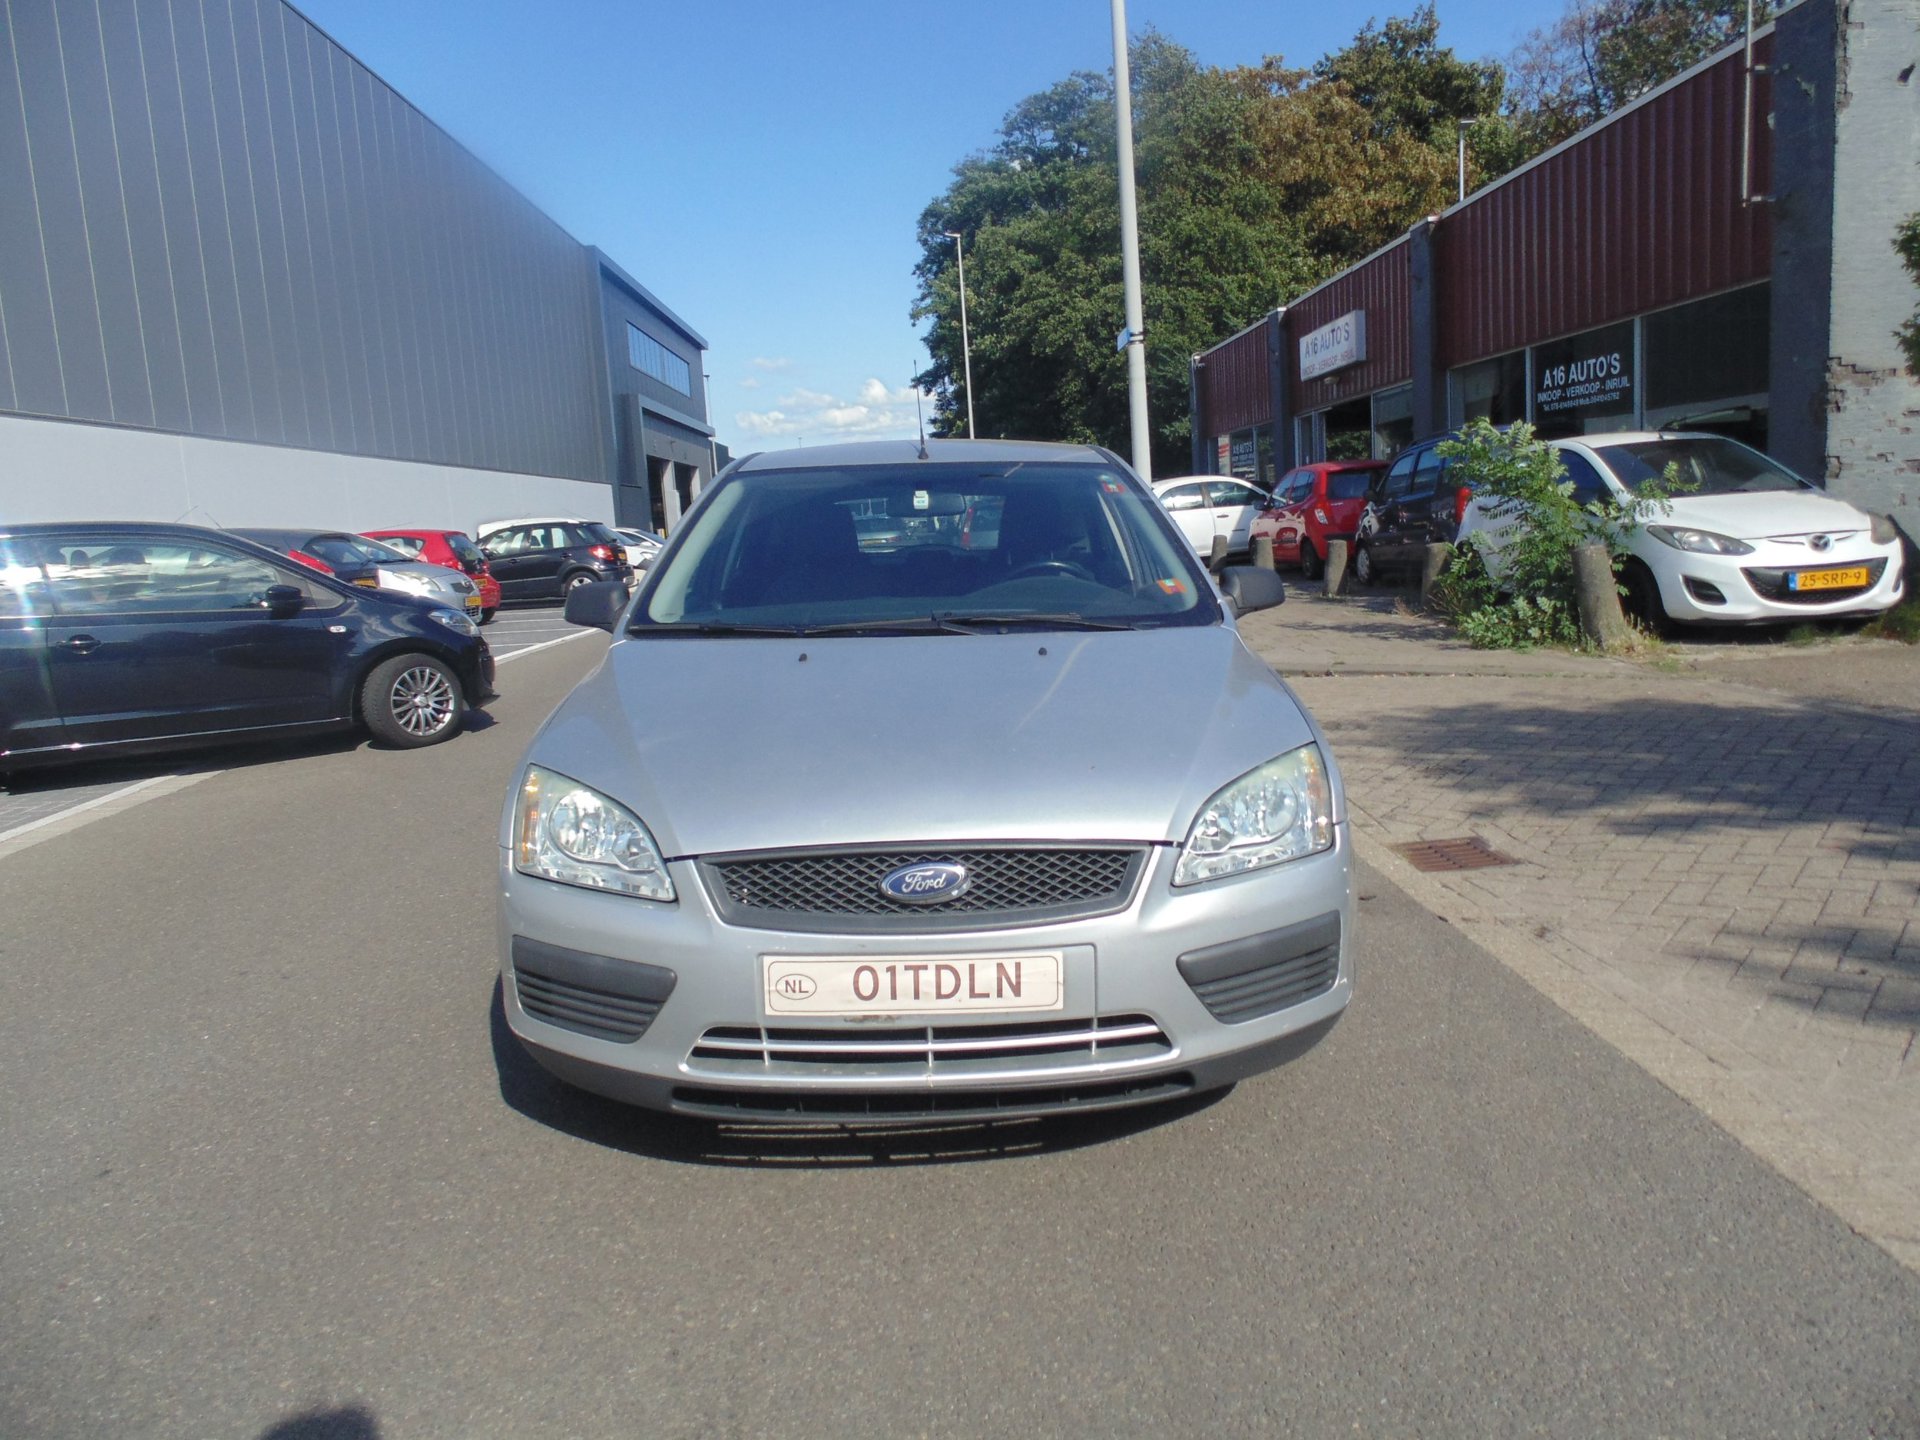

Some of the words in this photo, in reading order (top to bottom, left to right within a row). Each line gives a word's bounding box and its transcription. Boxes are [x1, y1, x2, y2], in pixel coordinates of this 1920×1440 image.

[1305, 337, 1319, 358] A16
[1320, 322, 1350, 352] AUTO'S
[1543, 366, 1565, 389] A16
[1568, 353, 1620, 384] AUTO'S
[1537, 389, 1561, 403] INKOOP
[1566, 381, 1600, 398] VERKOOP
[1605, 376, 1630, 391] INRUIL
[1800, 571, 1861, 587] 25-SRP-9
[902, 870, 946, 893] Ford
[784, 979, 809, 994] NL
